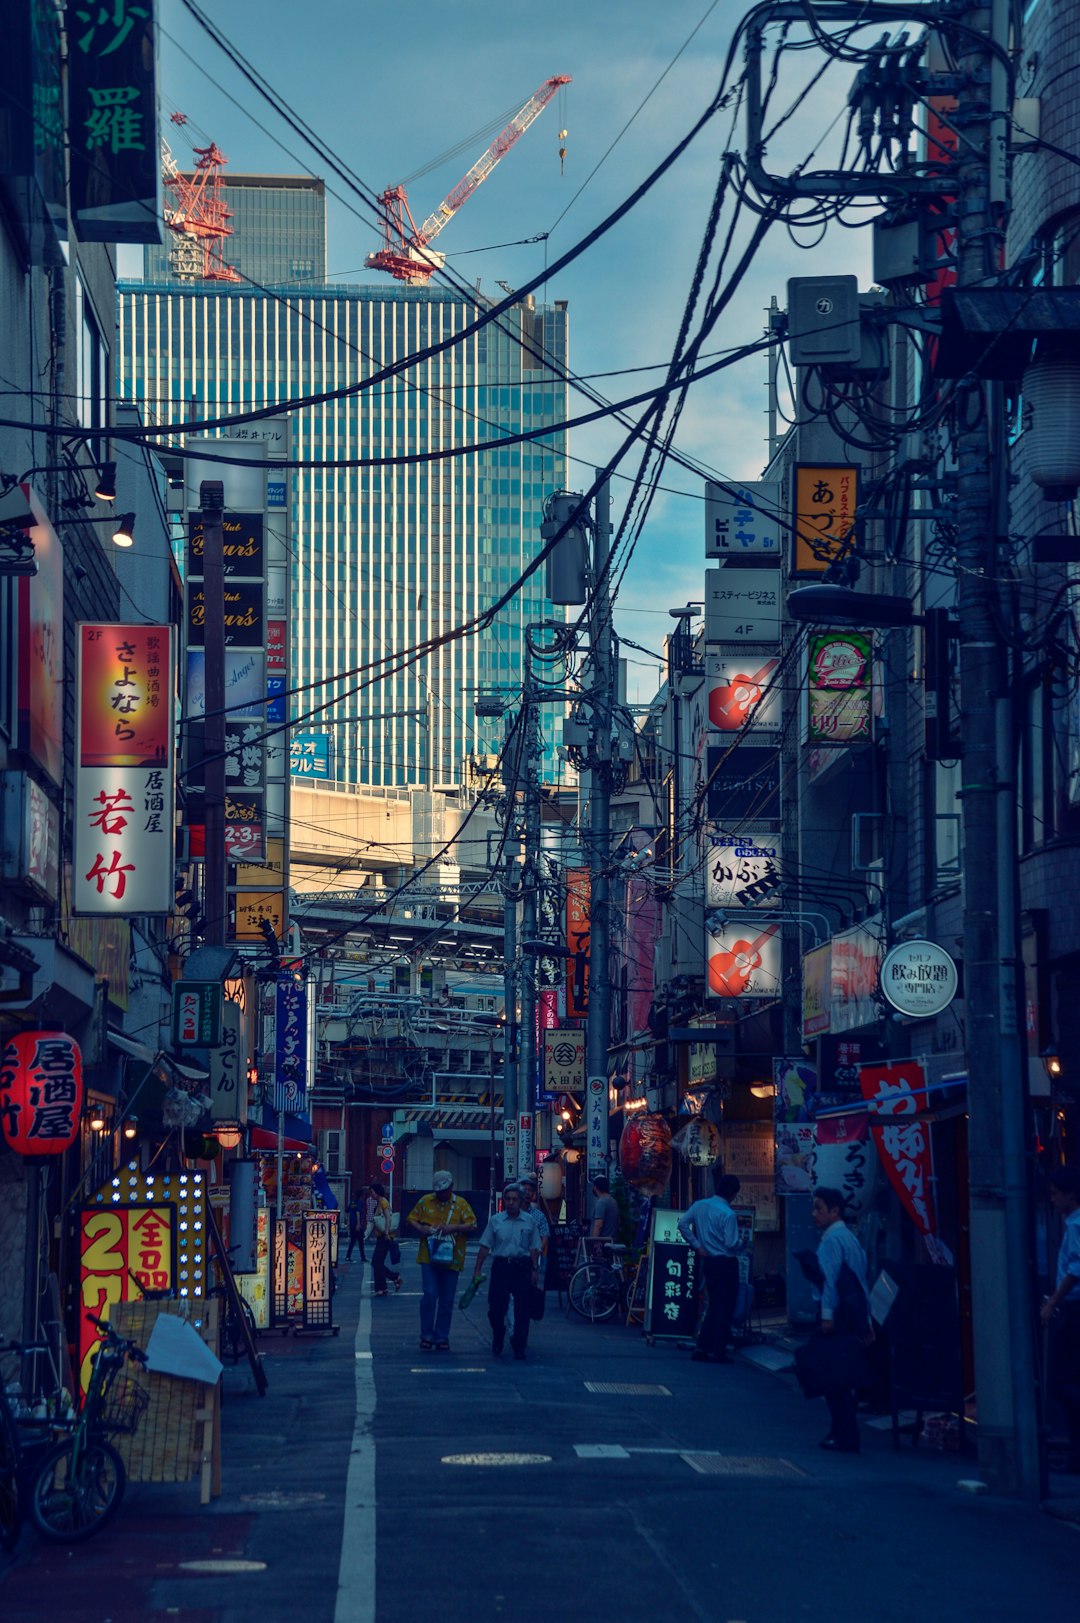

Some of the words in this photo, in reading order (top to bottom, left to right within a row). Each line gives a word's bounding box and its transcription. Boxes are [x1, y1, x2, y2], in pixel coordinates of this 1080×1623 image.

[713, 591, 777, 600] エスティービジネス
[88, 631, 105, 641] 2F
[735, 625, 754, 635] 4F
[147, 637, 160, 708] 歌謡曲酒場
[715, 663, 729, 672] 3F
[111, 641, 141, 741] さよなら
[144, 770, 163, 833] 居酒屋
[86, 788, 136, 900] 若竹
[892, 964, 948, 981] 飲み放題
[217, 1026, 241, 1094] おでん
[28, 1040, 78, 1141] 居酒屋
[548, 1075, 582, 1086] 大田屋
